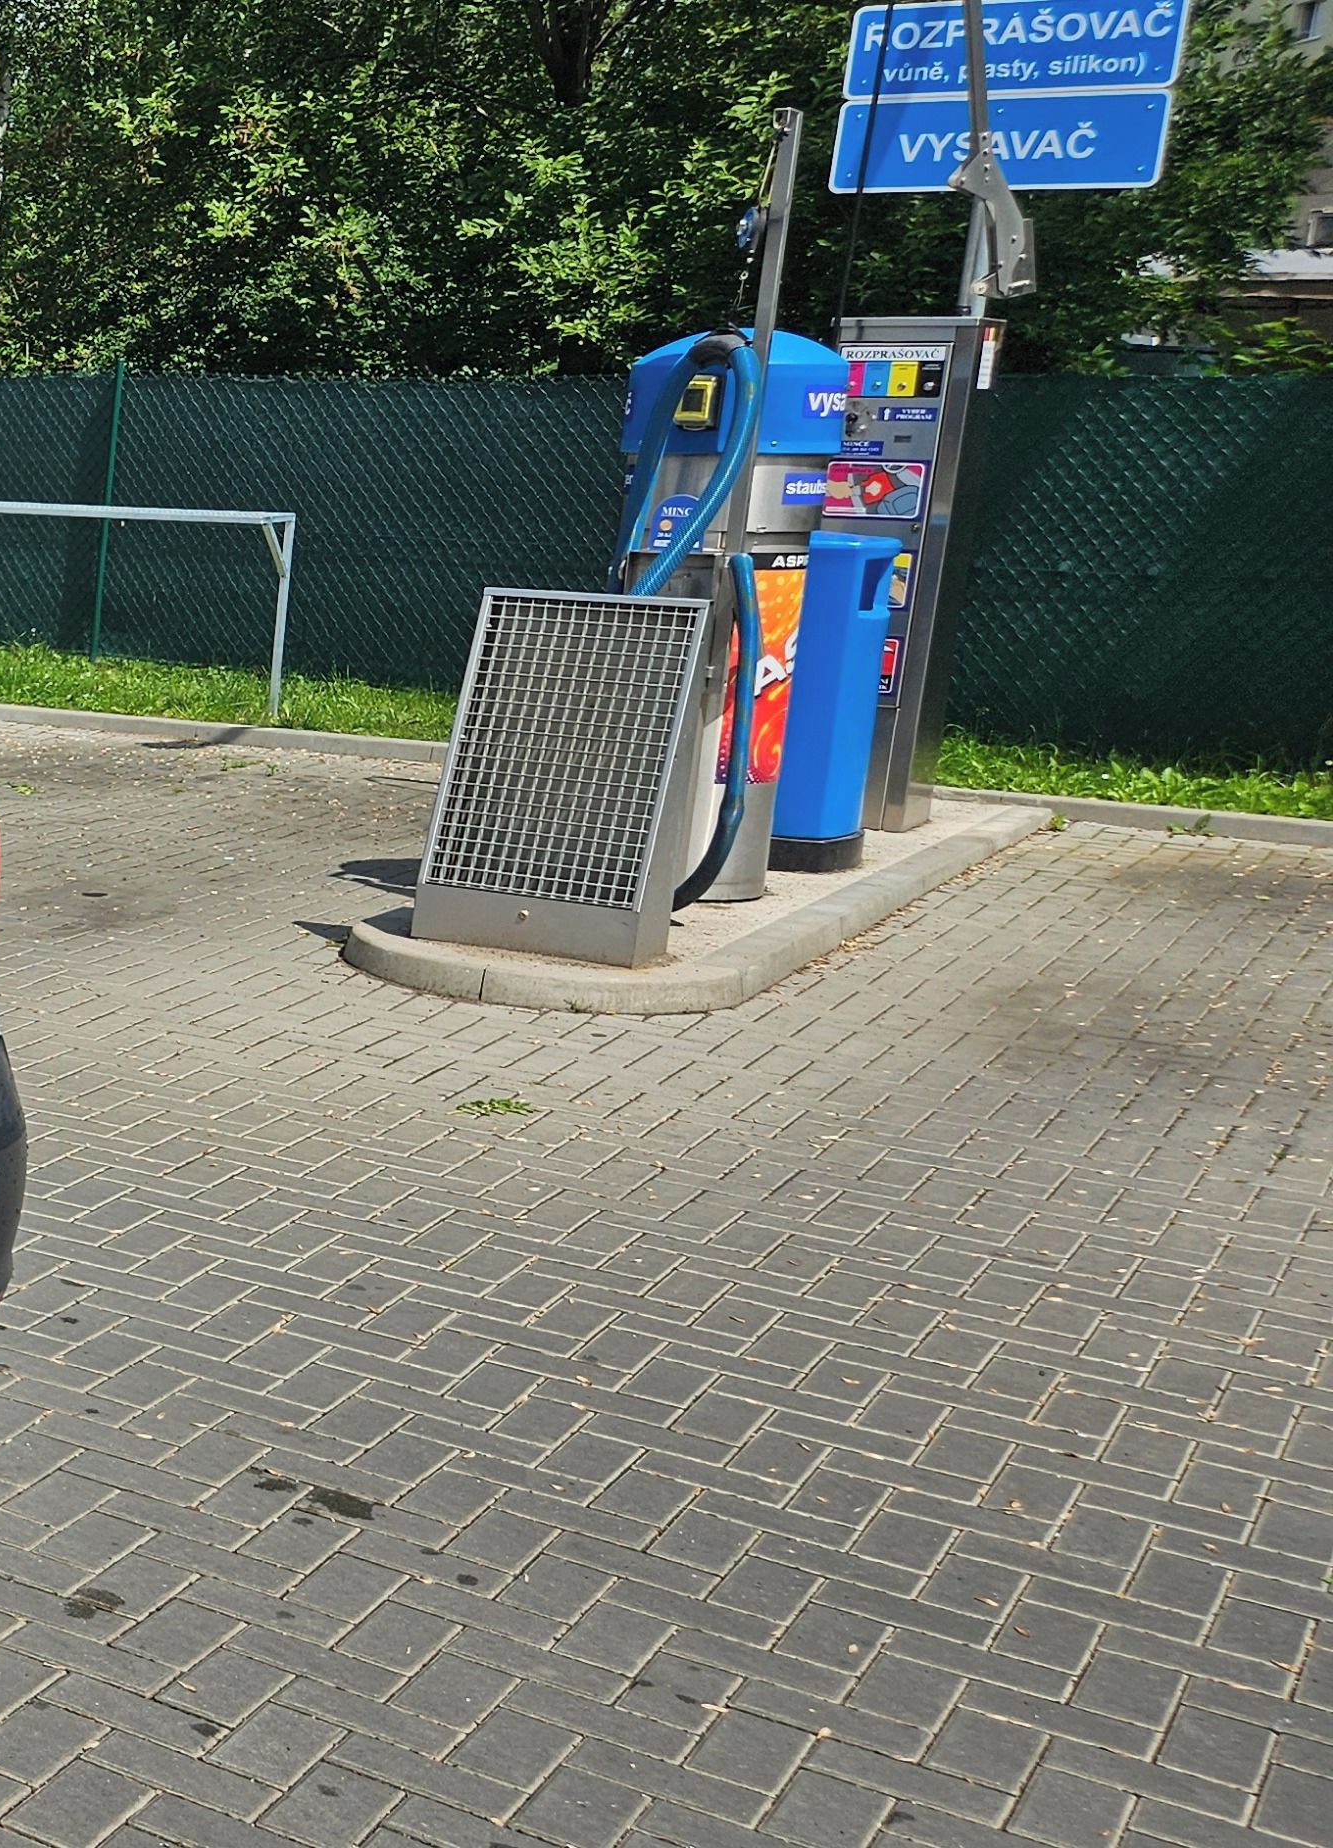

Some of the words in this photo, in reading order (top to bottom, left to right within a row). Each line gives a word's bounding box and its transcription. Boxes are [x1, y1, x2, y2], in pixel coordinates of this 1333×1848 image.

[882, 58, 950, 84] vůně,
[957, 58, 1041, 85] pasty,
[1047, 52, 1149, 78] silikon)
[899, 121, 1098, 163] VYSAVAČ
